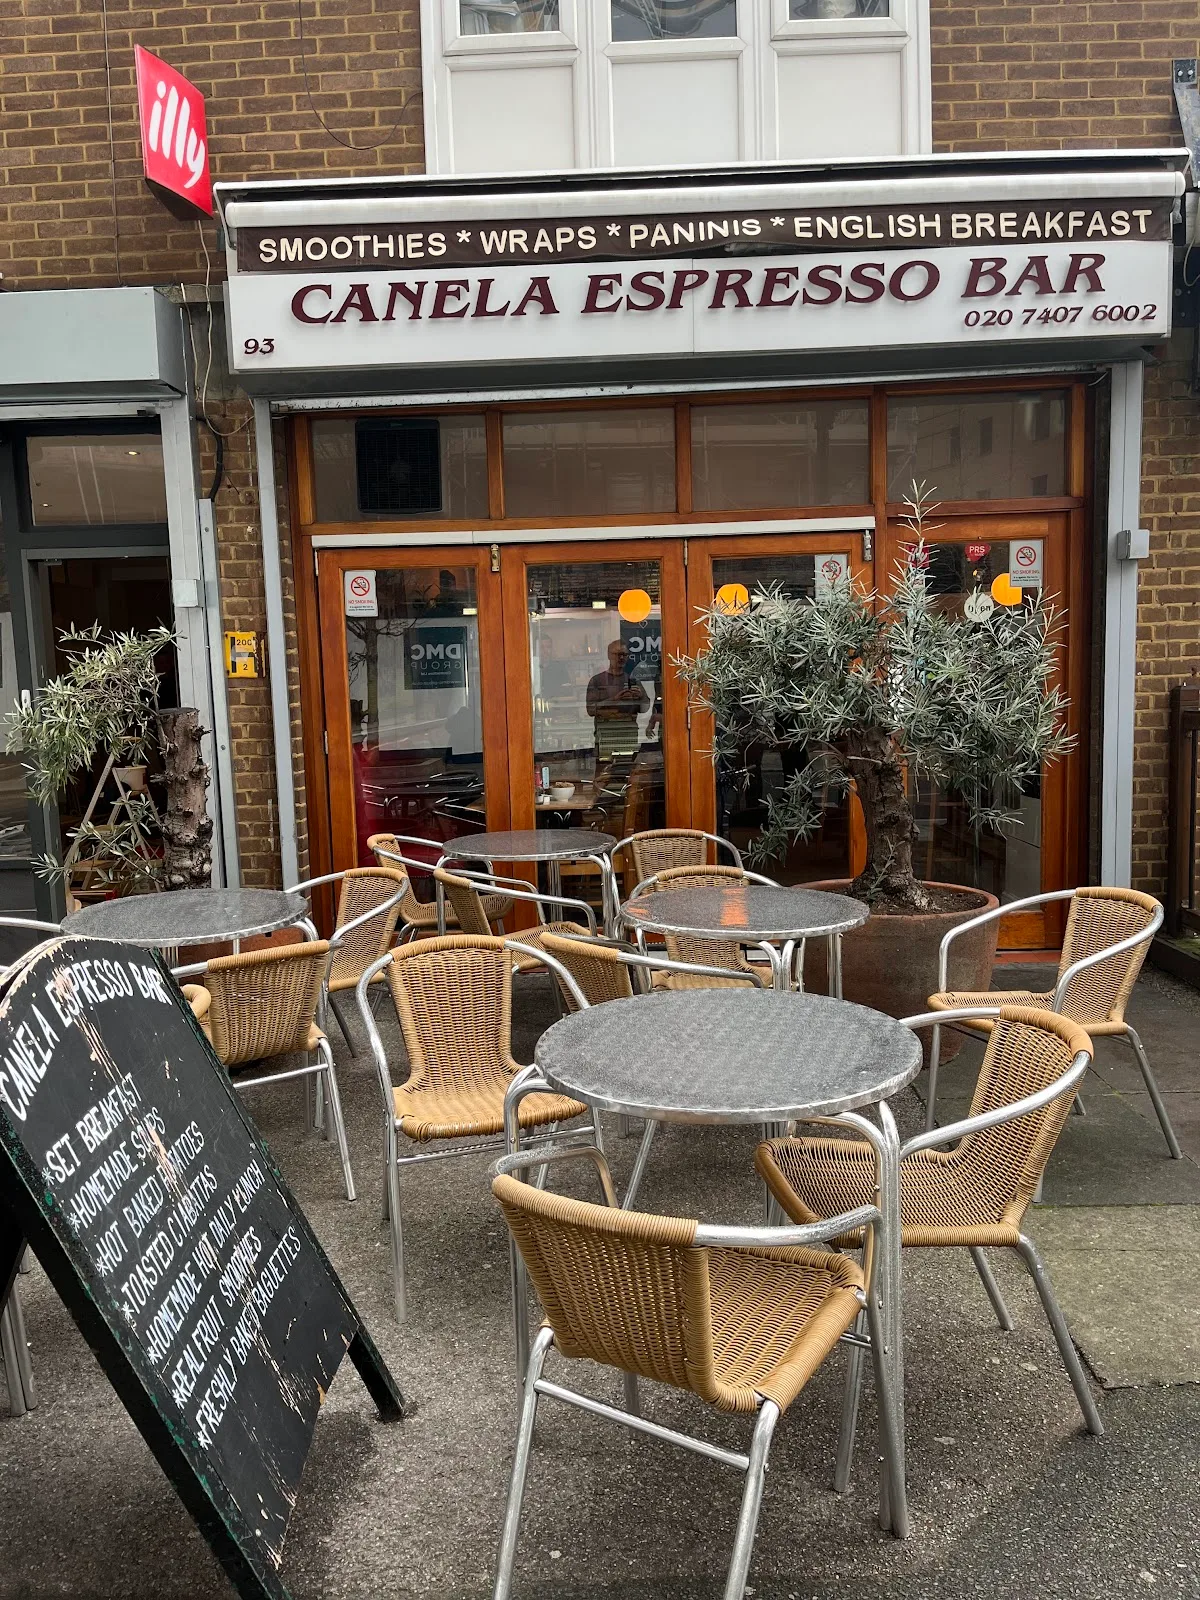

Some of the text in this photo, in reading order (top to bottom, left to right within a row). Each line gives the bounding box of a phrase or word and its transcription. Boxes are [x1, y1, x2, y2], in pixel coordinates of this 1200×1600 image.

[149, 80, 206, 189] illy
[258, 209, 1153, 263] SMOOTHIES WRAPS PANINIS ENGLISH BREAKFAST
[290, 253, 1107, 325] CANELA ESPRESSO BAR
[964, 302, 1157, 328] 020 7407 6002
[243, 337, 275, 356] 93
[969, 545, 985, 554] PRS
[0, 959, 172, 1121] CANELA ESPRESSO BAR
[45, 1072, 142, 1184] SET BREAKFAST
[70, 1141, 138, 1229] HOMEMADE
[95, 1220, 129, 1273] HOT
[122, 1174, 164, 1239] BAKED
[120, 1164, 218, 1315] TOASTED CIABATTAS
[145, 1158, 266, 1360] HOMEMADE HOT DAILY LUNCH
[218, 1225, 263, 1308] SMOOTHIES
[195, 1225, 302, 1434] FRESHLY BAKED BAGUETTES
